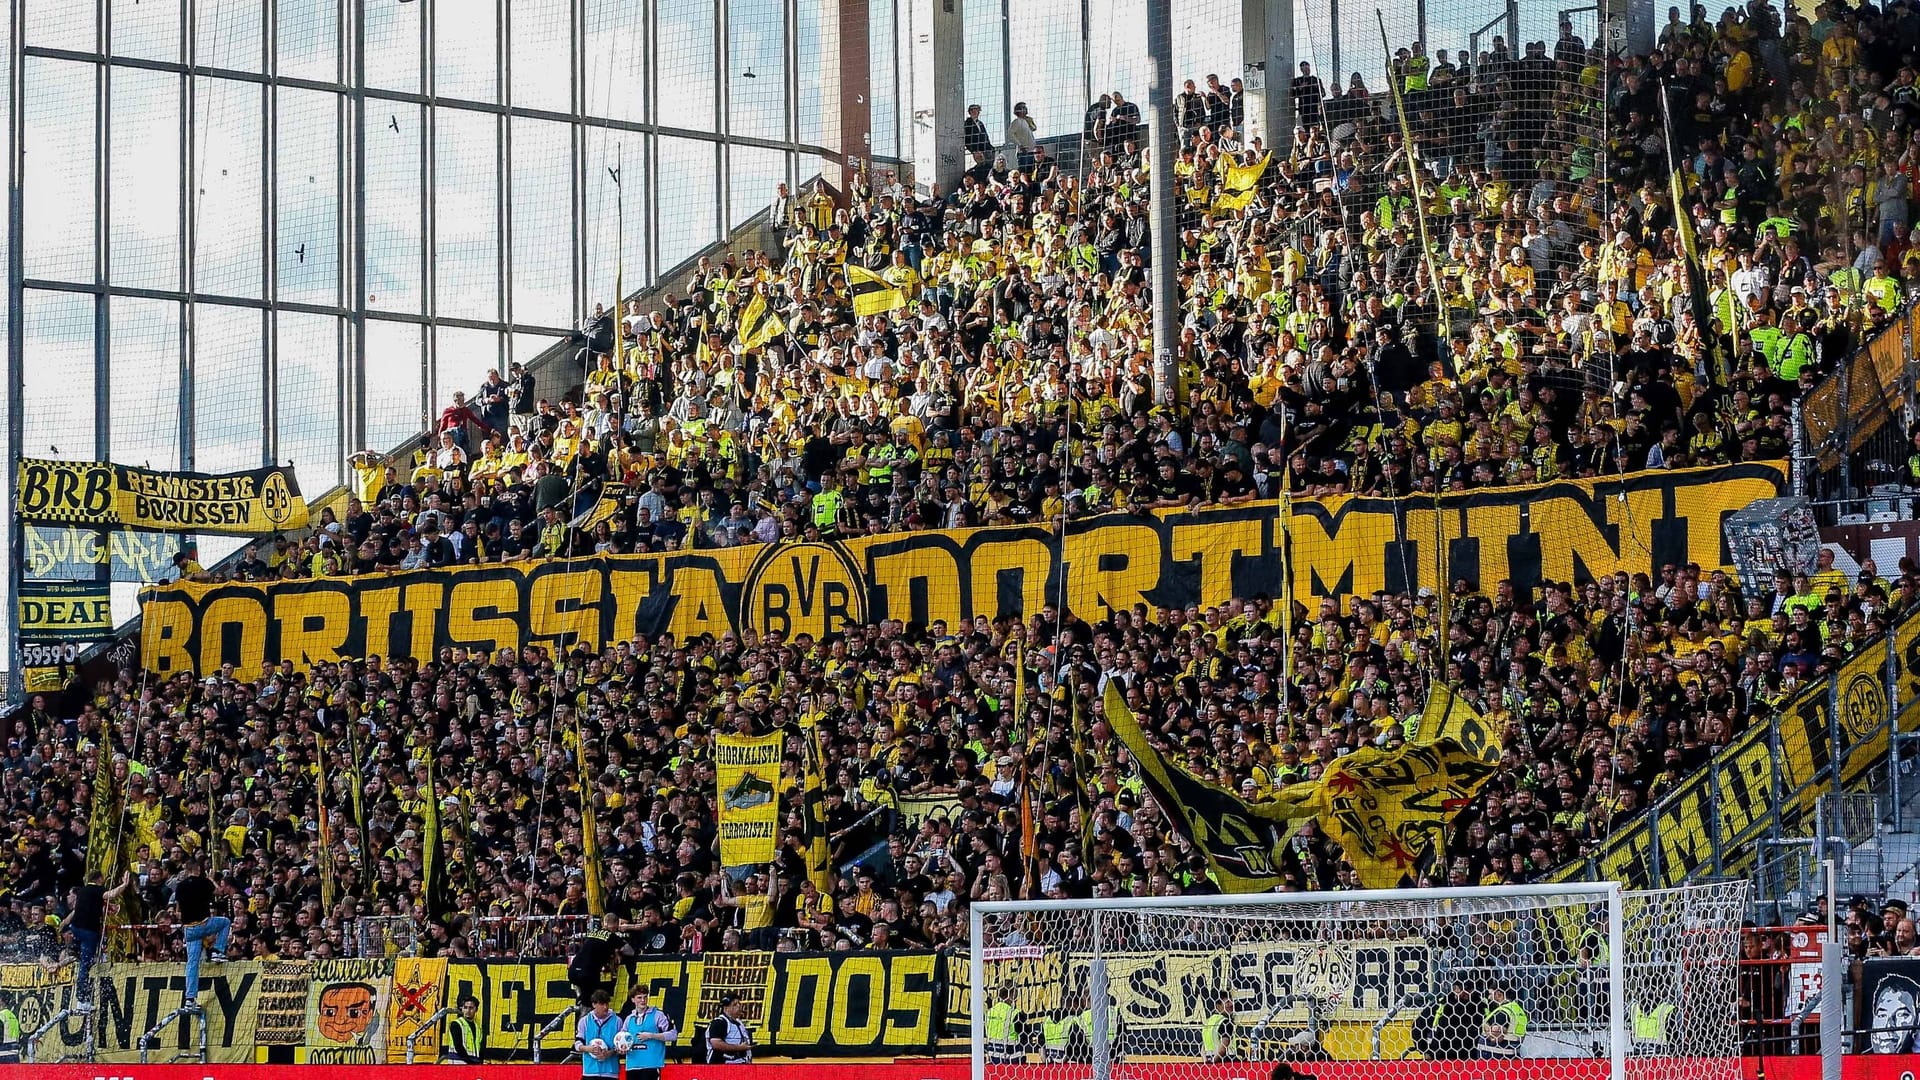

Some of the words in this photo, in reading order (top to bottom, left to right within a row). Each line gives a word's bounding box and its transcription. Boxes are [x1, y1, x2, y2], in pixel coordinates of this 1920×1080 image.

[24, 465, 112, 516] BRB
[127, 470, 255, 500] RENNSTEIG
[136, 500, 251, 524] BORUSSEN
[22, 600, 110, 624] DEAF
[141, 558, 742, 680] BORUSSIA
[763, 555, 850, 642] BVB
[718, 744, 779, 764] GIORNALISTA
[721, 822, 773, 839] TERRORISTA!
